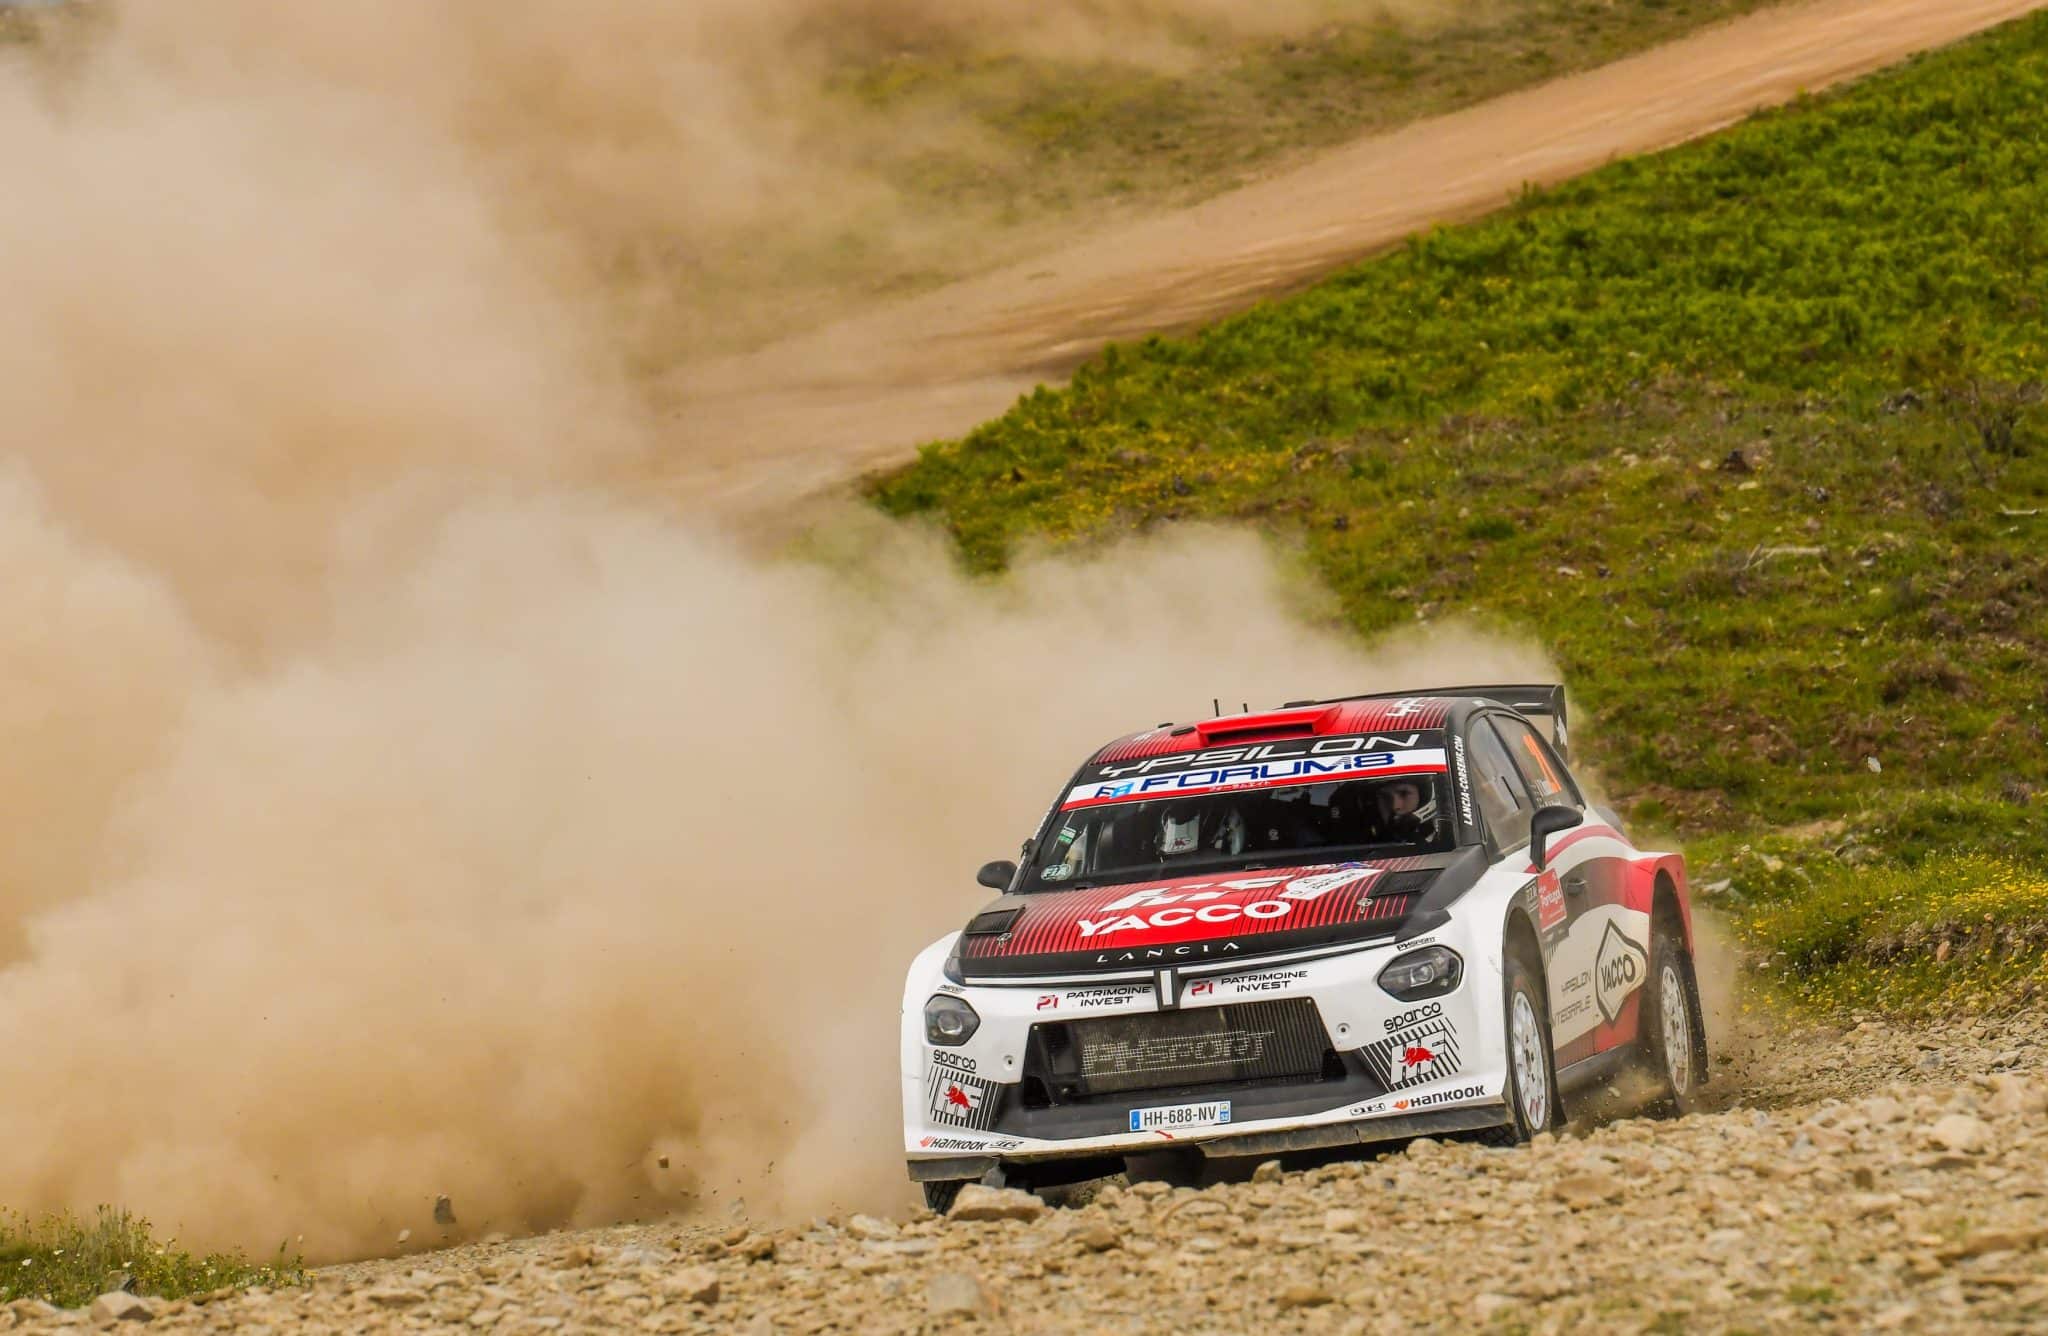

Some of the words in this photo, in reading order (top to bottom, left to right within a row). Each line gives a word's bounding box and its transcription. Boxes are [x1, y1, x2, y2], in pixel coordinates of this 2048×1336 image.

[1100, 734, 1420, 778] YPSILON
[1141, 753, 1395, 792] FORUM8
[1077, 900, 1291, 937] YACCO
[1096, 942, 1240, 963] LANCIA
[1221, 970, 1308, 986] PATRIMOINE
[1601, 953, 1635, 992] YACCO
[1066, 986, 1151, 999] PATRIMOINE
[1237, 981, 1291, 993] INVEST
[1080, 996, 1134, 1007] INVEST
[1384, 1002, 1441, 1031] sparco
[933, 1049, 976, 1070] sparco
[1144, 1106, 1217, 1126] HH-688-NV
